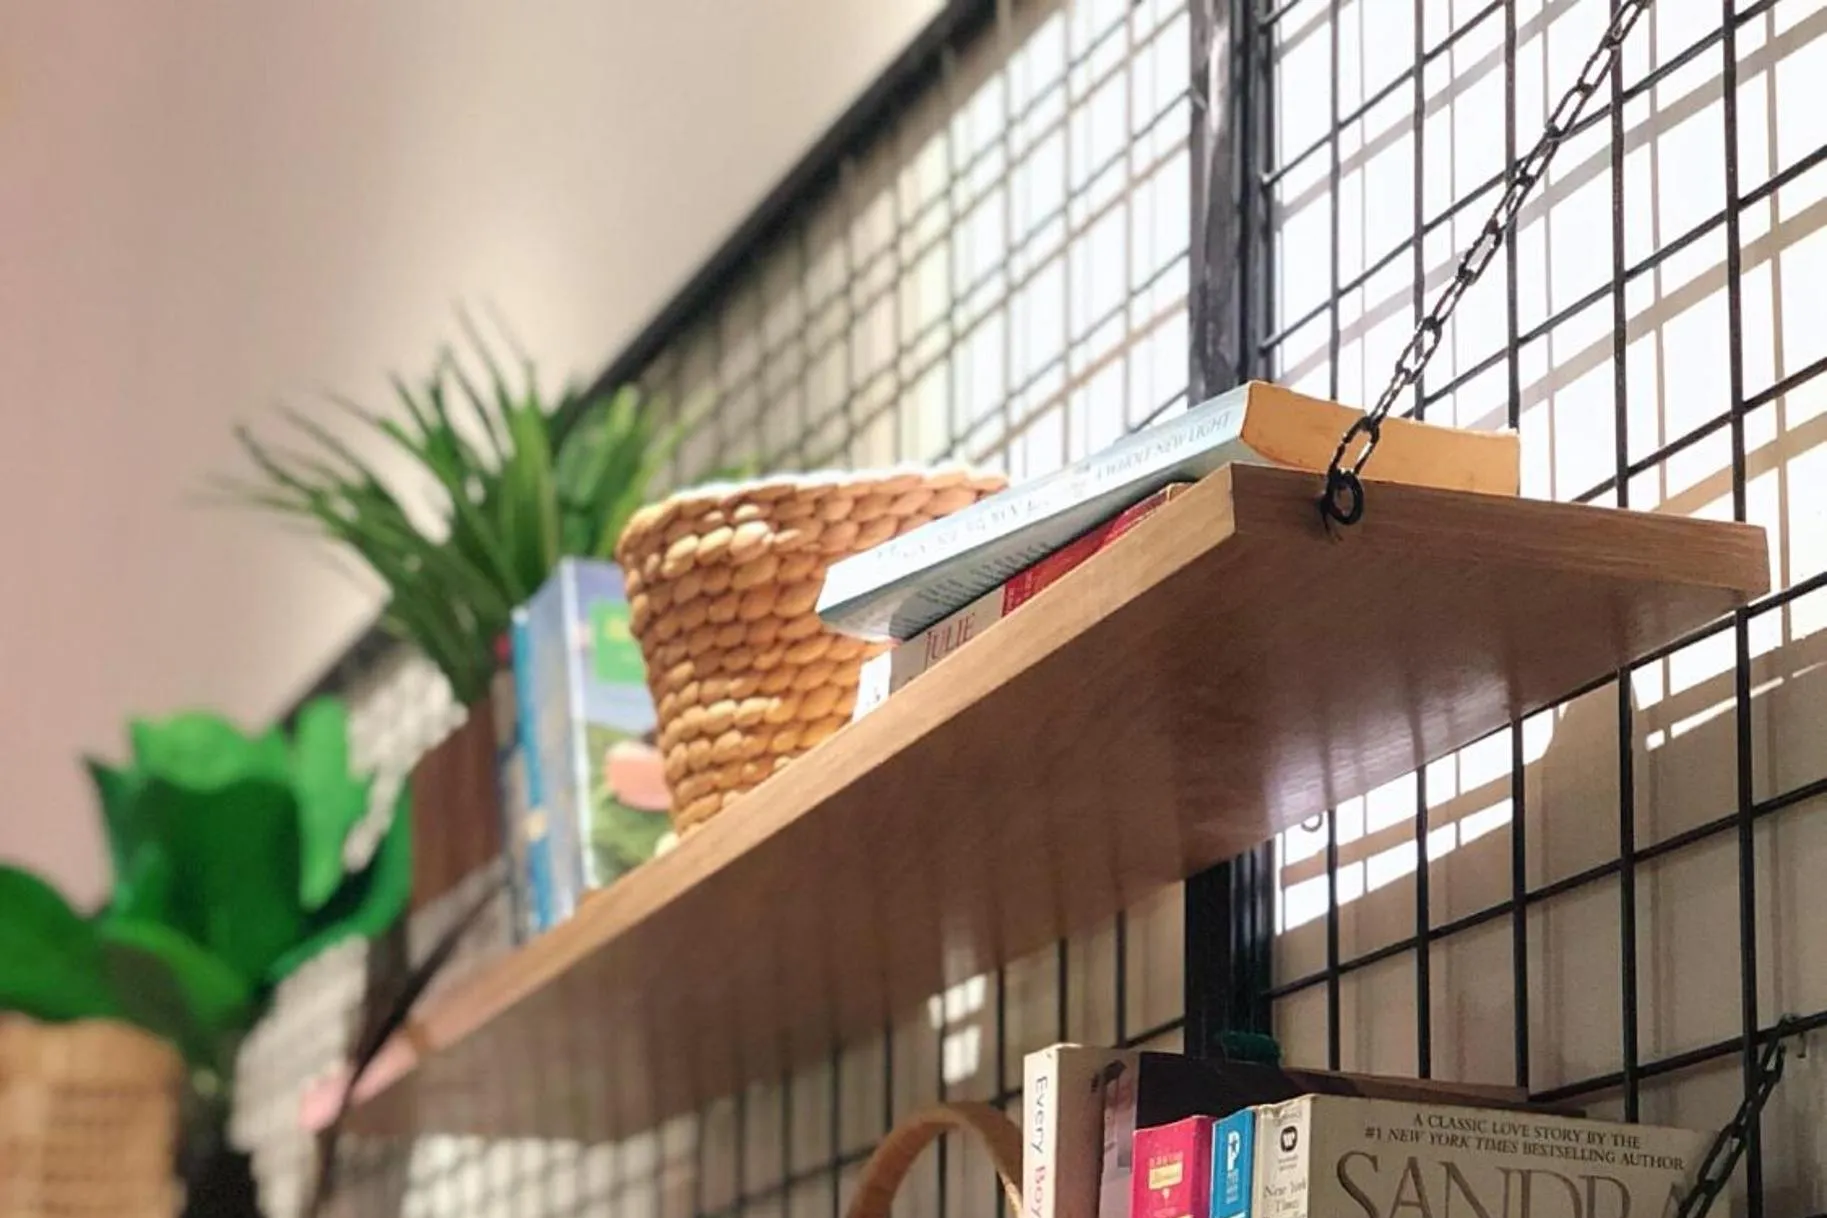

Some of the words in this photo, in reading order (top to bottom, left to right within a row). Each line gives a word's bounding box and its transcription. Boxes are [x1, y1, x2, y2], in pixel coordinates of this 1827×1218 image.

[1188, 410, 1232, 442] LIGHT
[924, 612, 976, 671] JULIE
[1030, 1075, 1048, 1156] Every
[1413, 1112, 1424, 1128] A
[1428, 1114, 1487, 1134] CLASSIC
[1492, 1119, 1530, 1138] LOVE
[1533, 1123, 1582, 1143] STORY
[1586, 1130, 1609, 1146] BY
[1611, 1133, 1641, 1150] THE
[1365, 1126, 1383, 1142] #1
[1388, 1128, 1425, 1146] NEW
[1429, 1131, 1470, 1149] YORK
[1476, 1136, 1519, 1154] TIMES
[1522, 1141, 1617, 1164] BESTSELLING
[1620, 1153, 1686, 1171] AUTHOR
